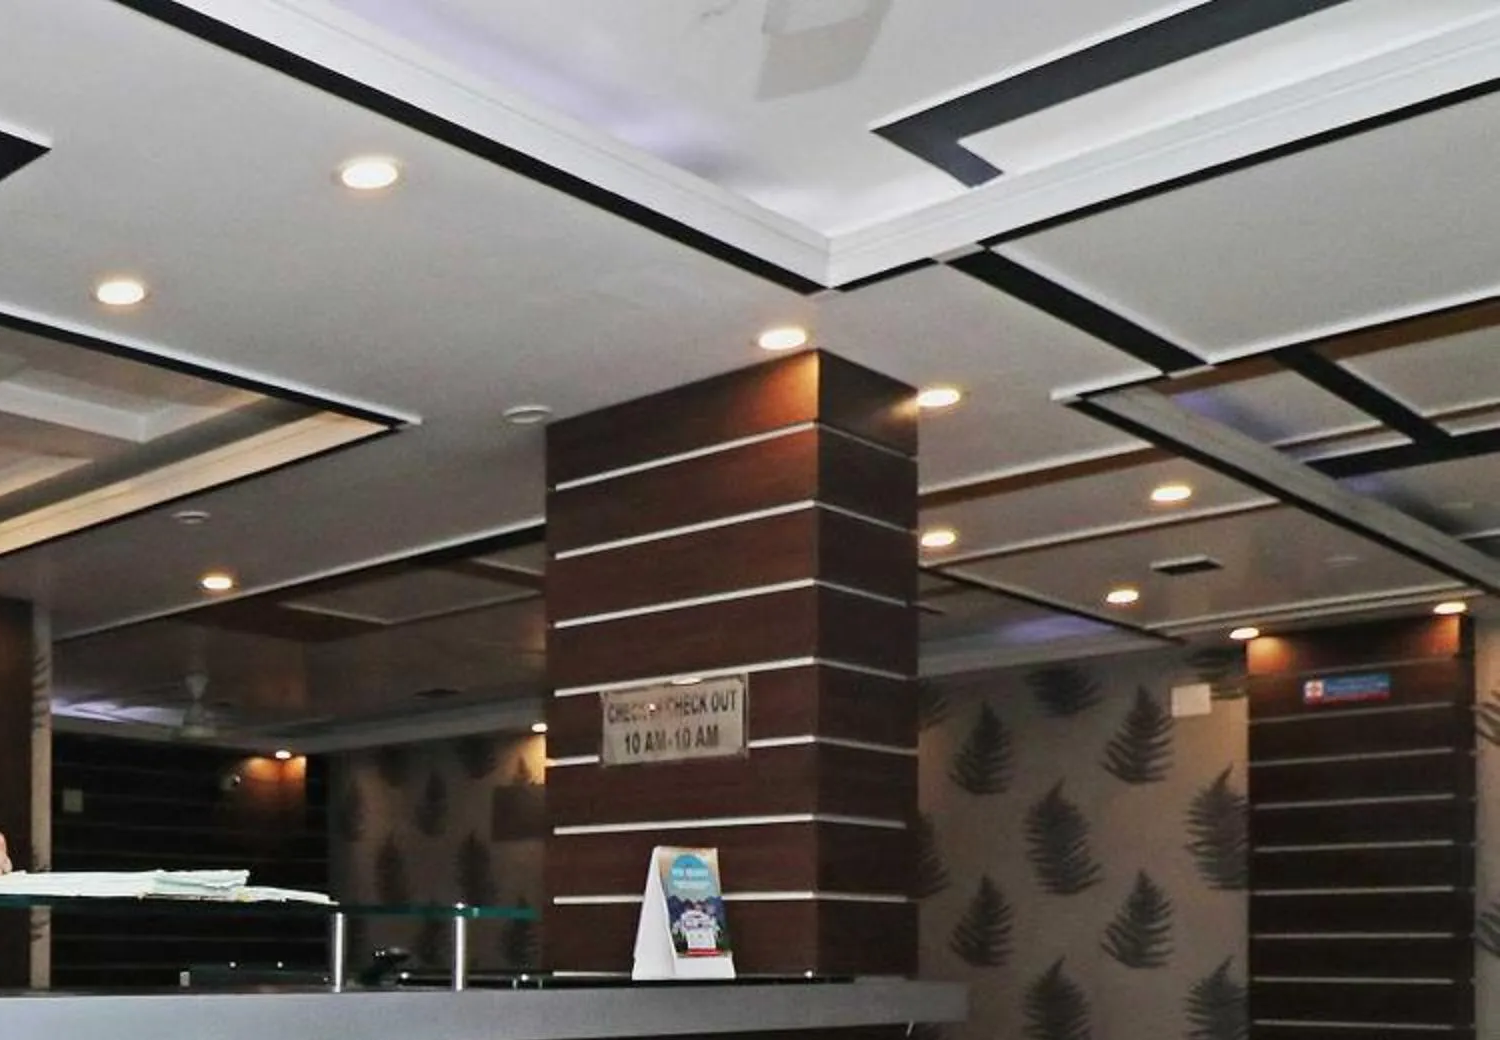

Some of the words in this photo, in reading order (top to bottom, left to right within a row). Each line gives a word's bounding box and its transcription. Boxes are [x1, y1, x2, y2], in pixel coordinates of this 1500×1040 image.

[711, 689, 737, 713] OUT
[625, 732, 640, 755] 10
[696, 724, 719, 748] AM
